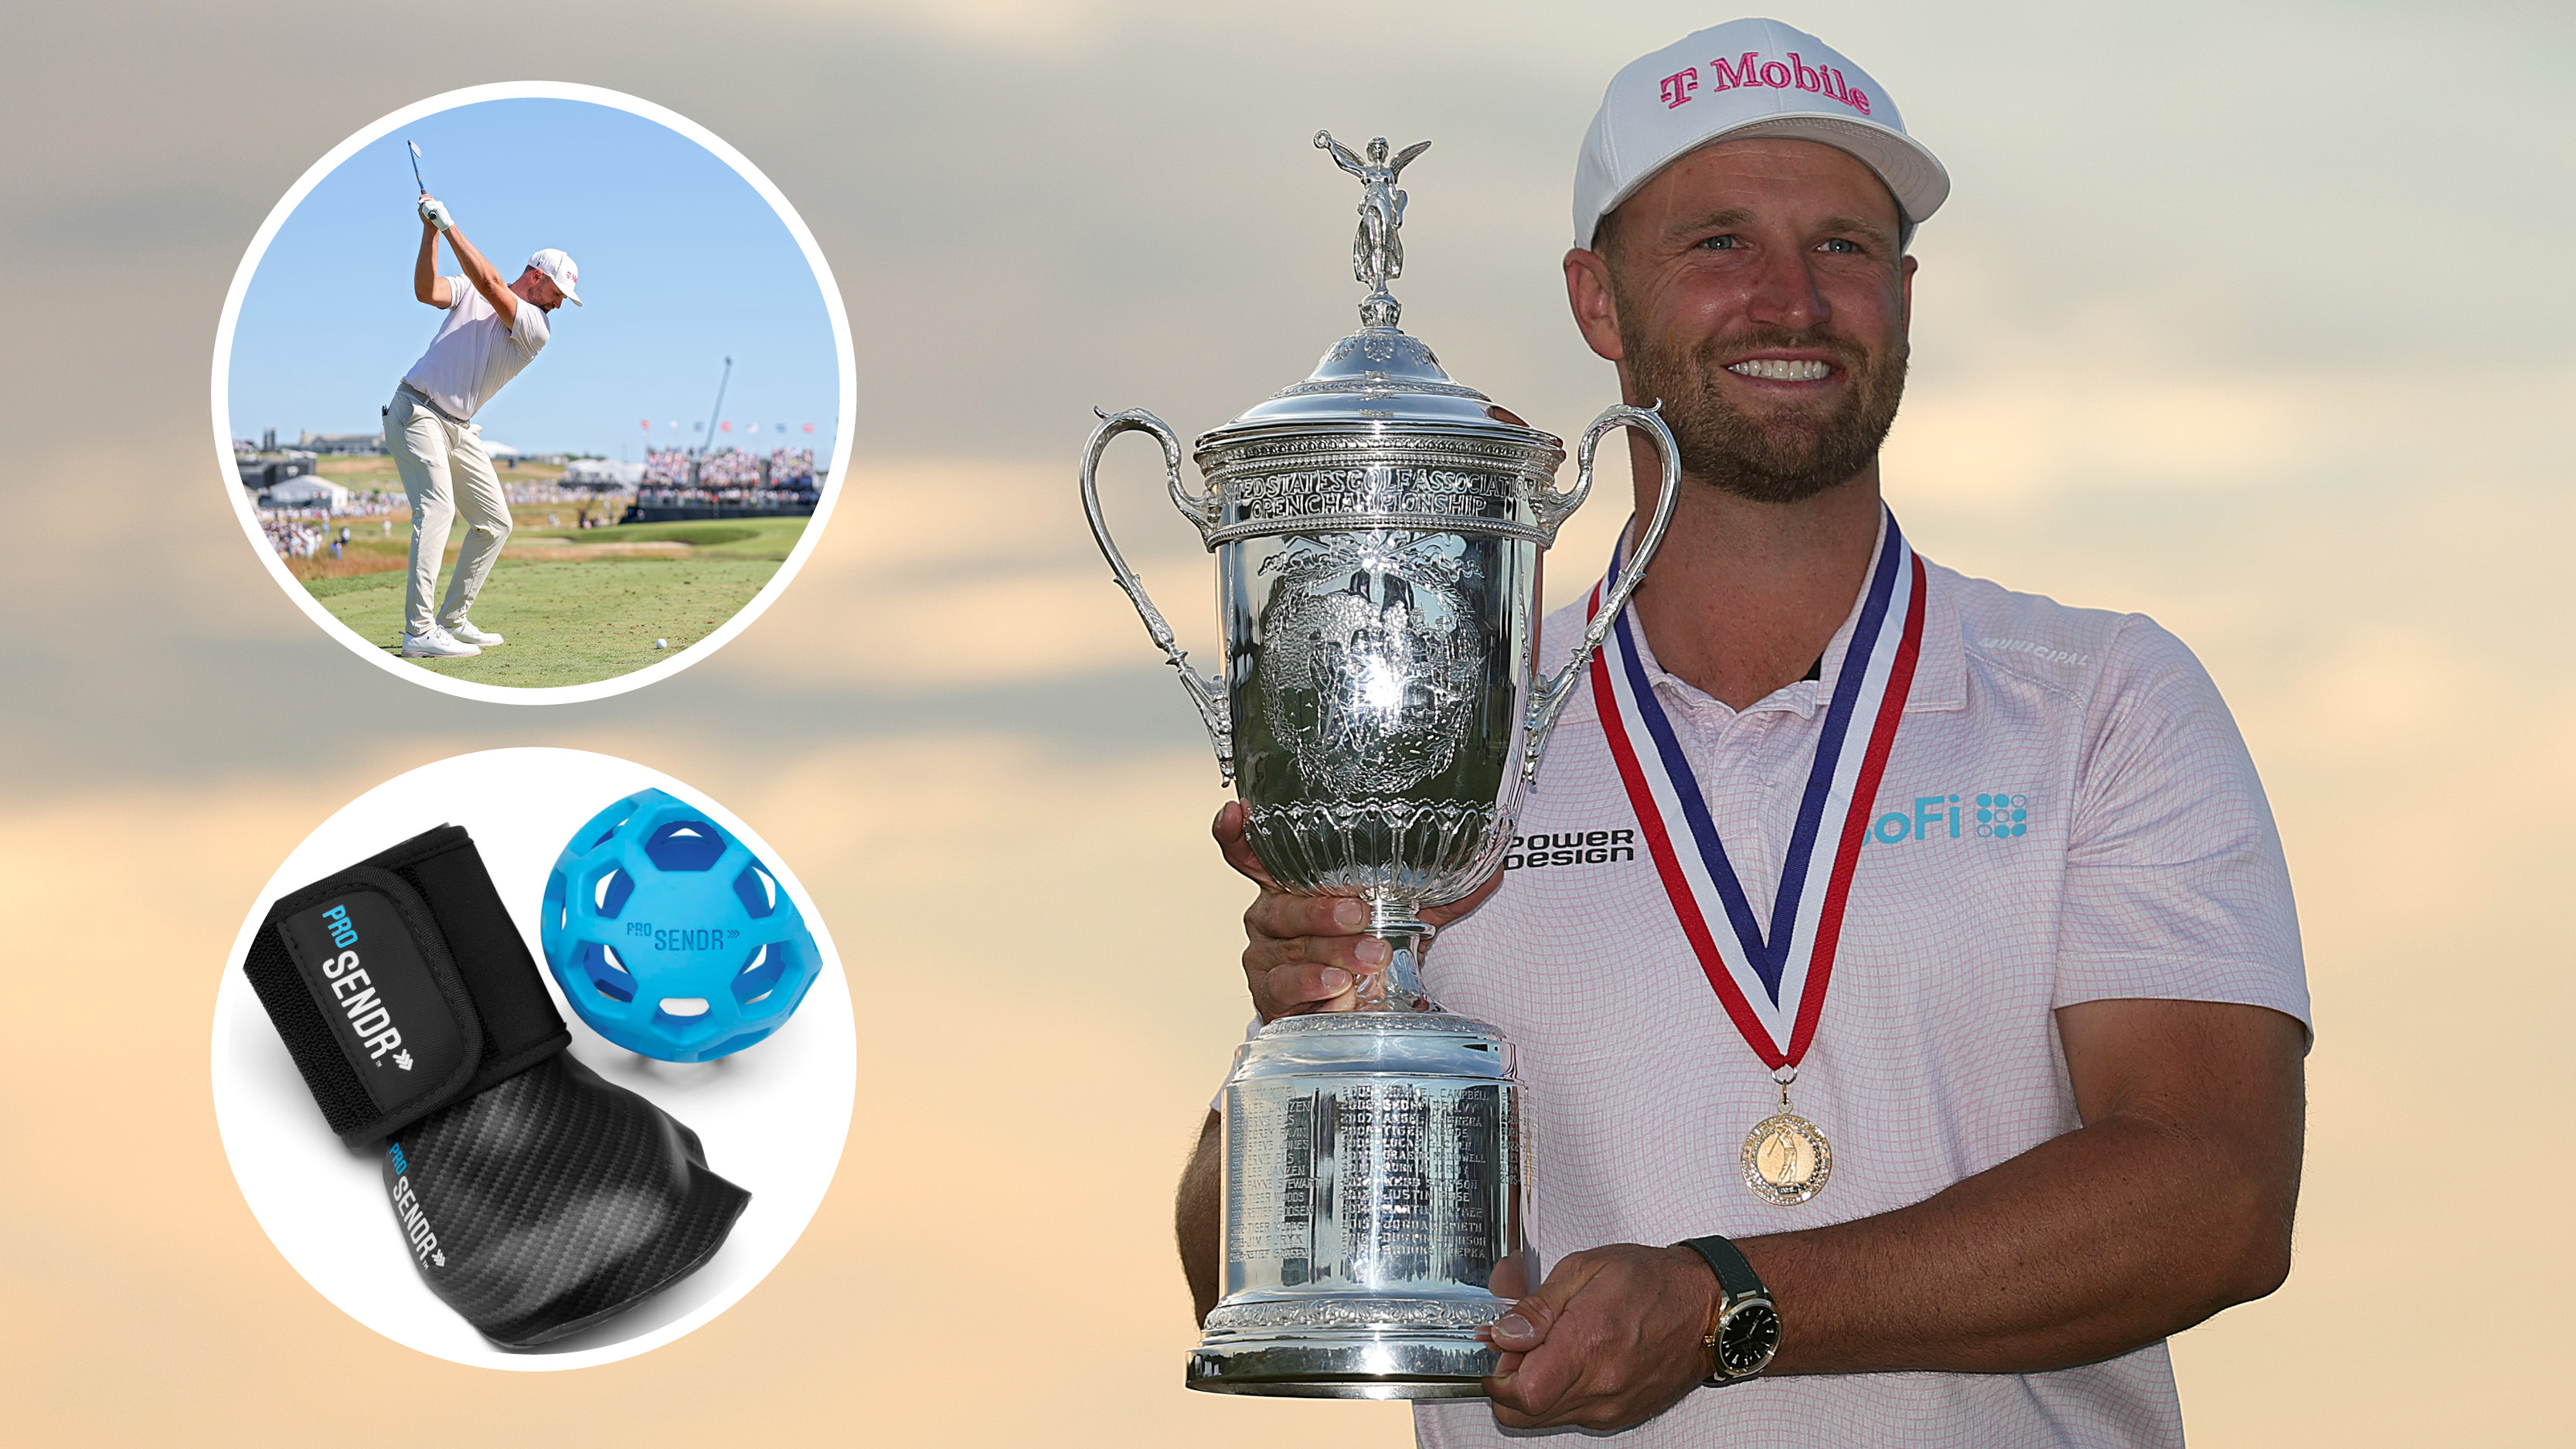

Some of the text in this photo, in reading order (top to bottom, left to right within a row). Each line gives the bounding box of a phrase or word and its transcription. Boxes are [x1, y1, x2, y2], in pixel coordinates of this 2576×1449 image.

[1660, 51, 1872, 115] T Mobile
[1251, 492, 1487, 519] OPEN CHAMPIONSHIP
[1978, 636, 2088, 666] MUNICIPAL
[1862, 794, 1961, 848] oFi
[322, 904, 359, 949] PRO
[627, 922, 724, 951] PRO SENDR
[322, 950, 403, 1060] SENDR
[389, 1141, 408, 1175] PRO
[393, 1175, 437, 1261] SENDR
